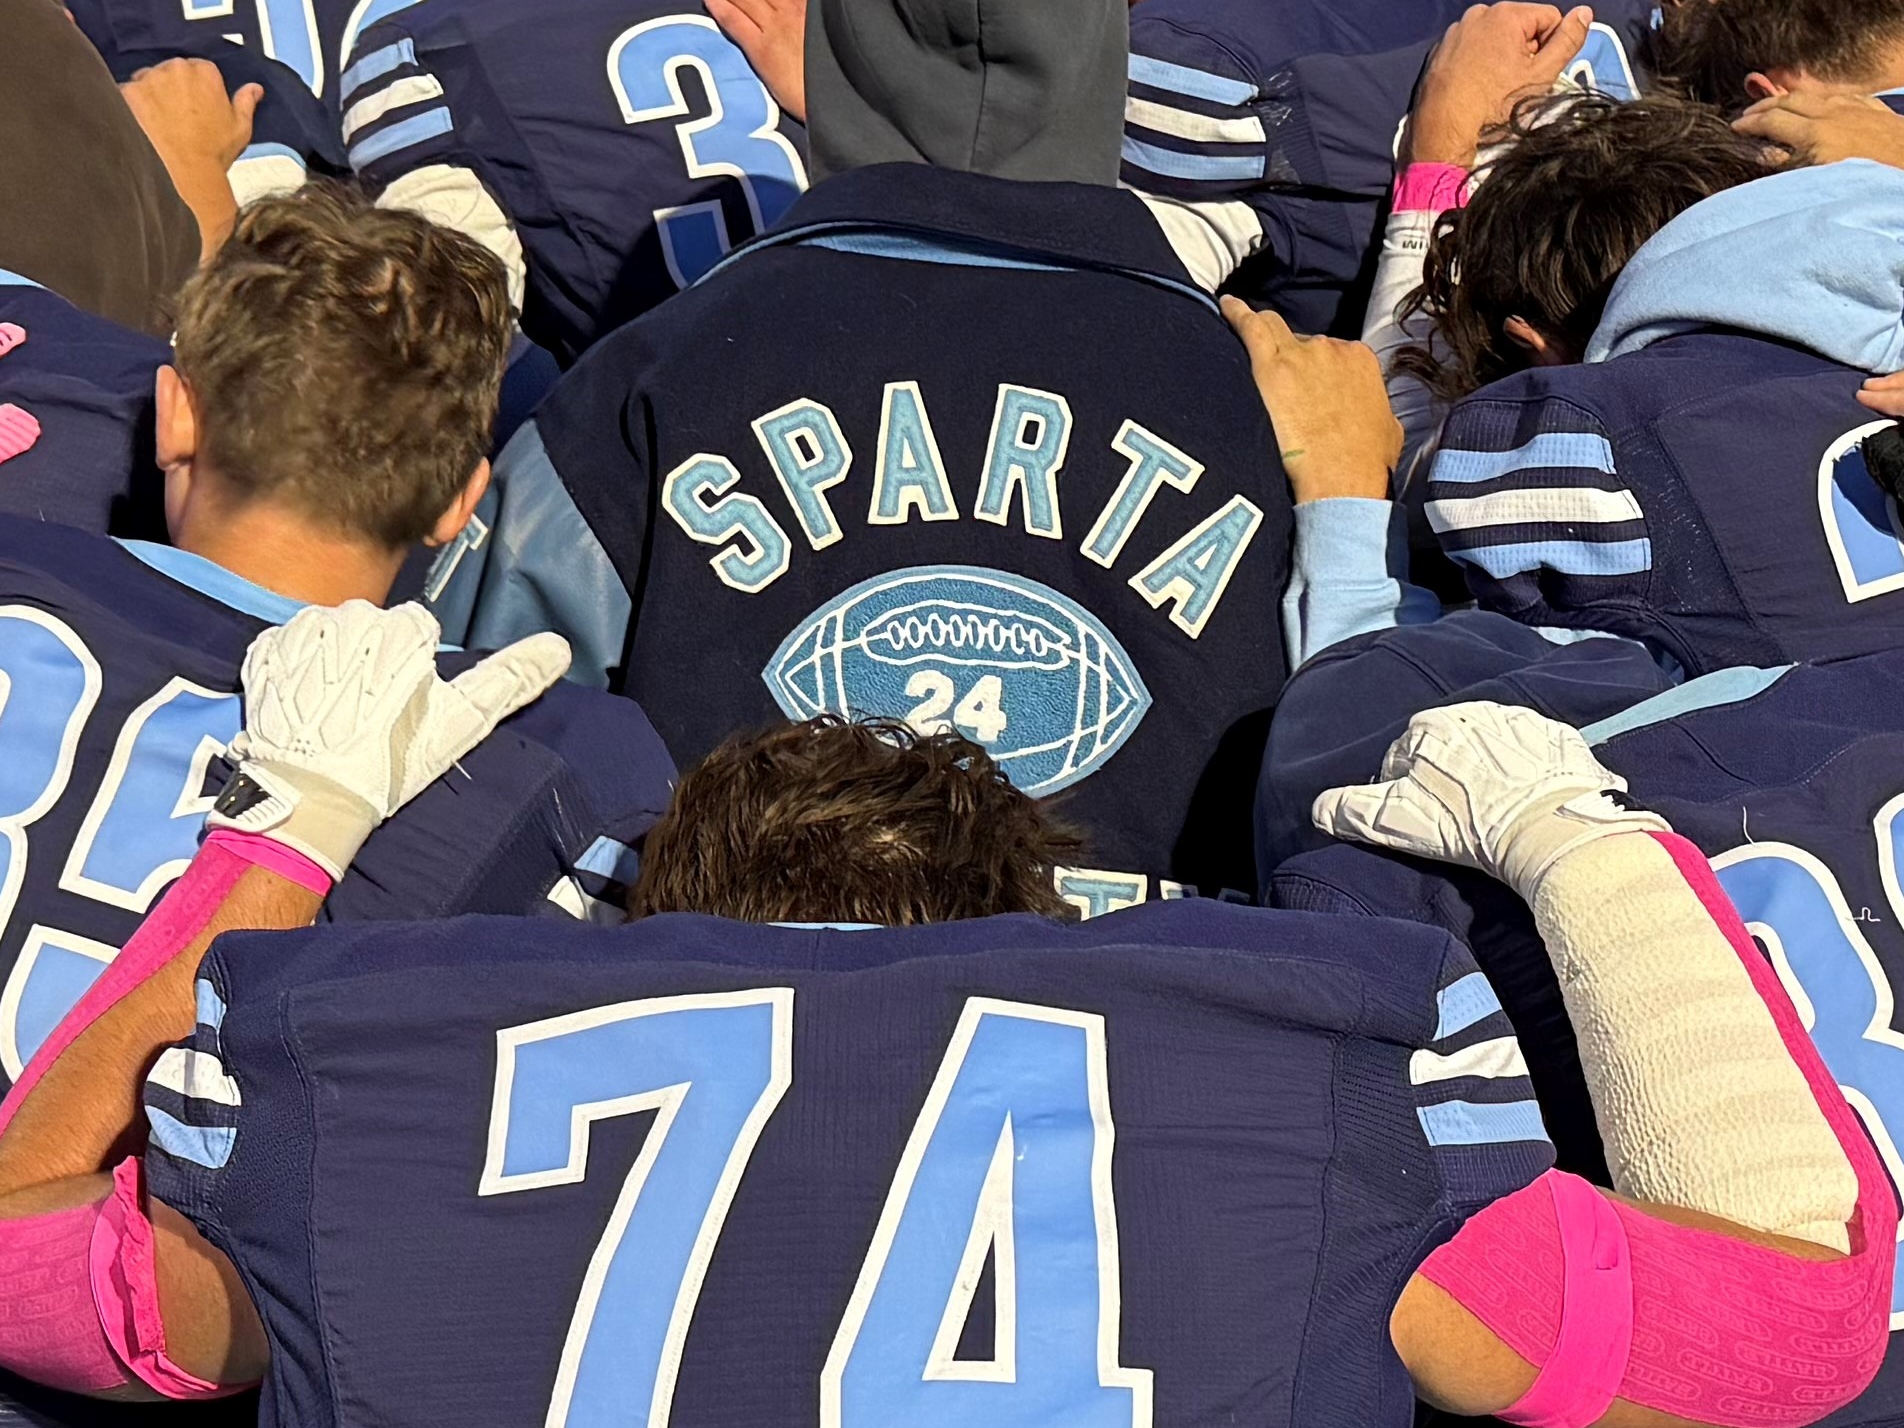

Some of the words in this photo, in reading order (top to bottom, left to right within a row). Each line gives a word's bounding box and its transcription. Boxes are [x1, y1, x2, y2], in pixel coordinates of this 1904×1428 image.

[607, 13, 809, 290] 3
[661, 380, 1264, 640] SPARTA
[903, 670, 1009, 743] 24
